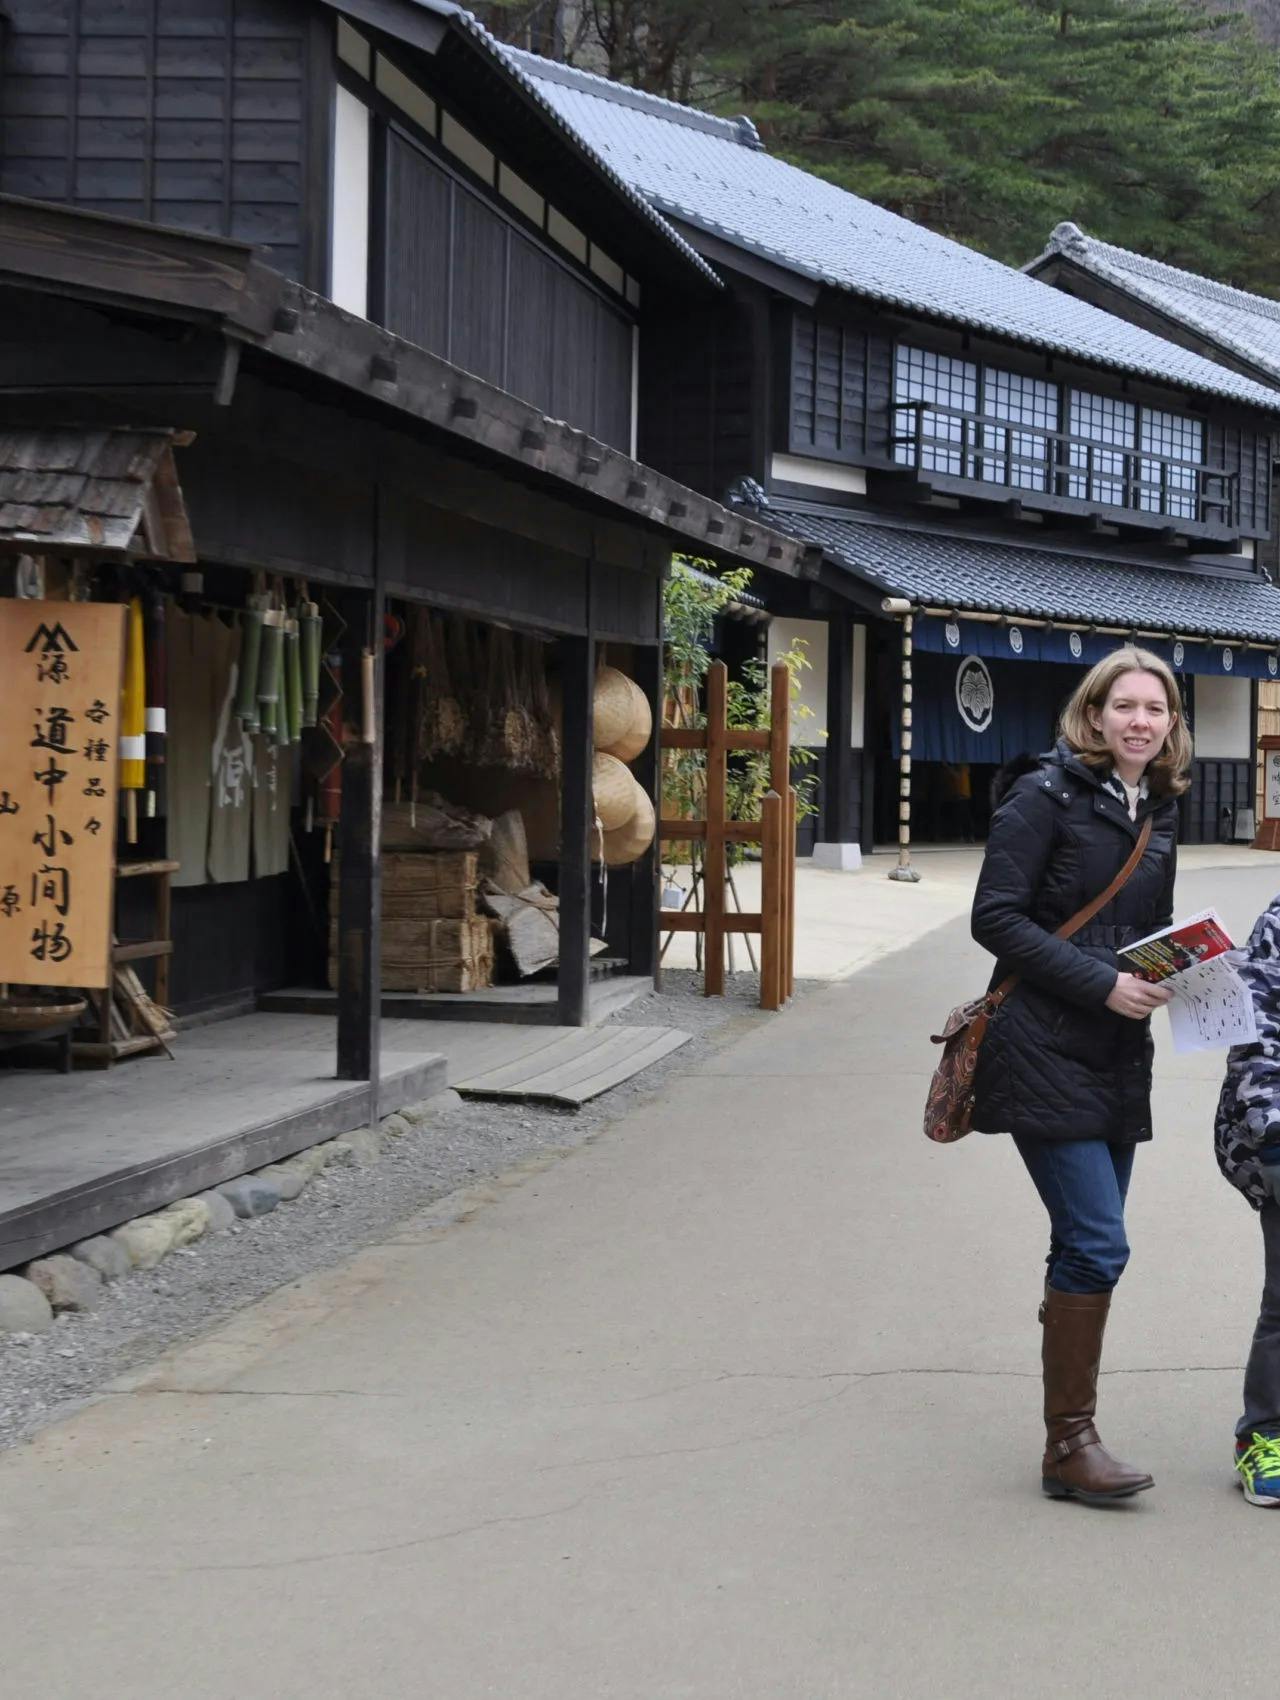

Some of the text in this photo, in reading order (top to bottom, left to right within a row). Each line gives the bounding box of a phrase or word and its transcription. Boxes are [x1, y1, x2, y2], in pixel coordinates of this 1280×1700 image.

[30, 706, 77, 963] 道中小間物
[83, 699, 111, 836] 各種品々
